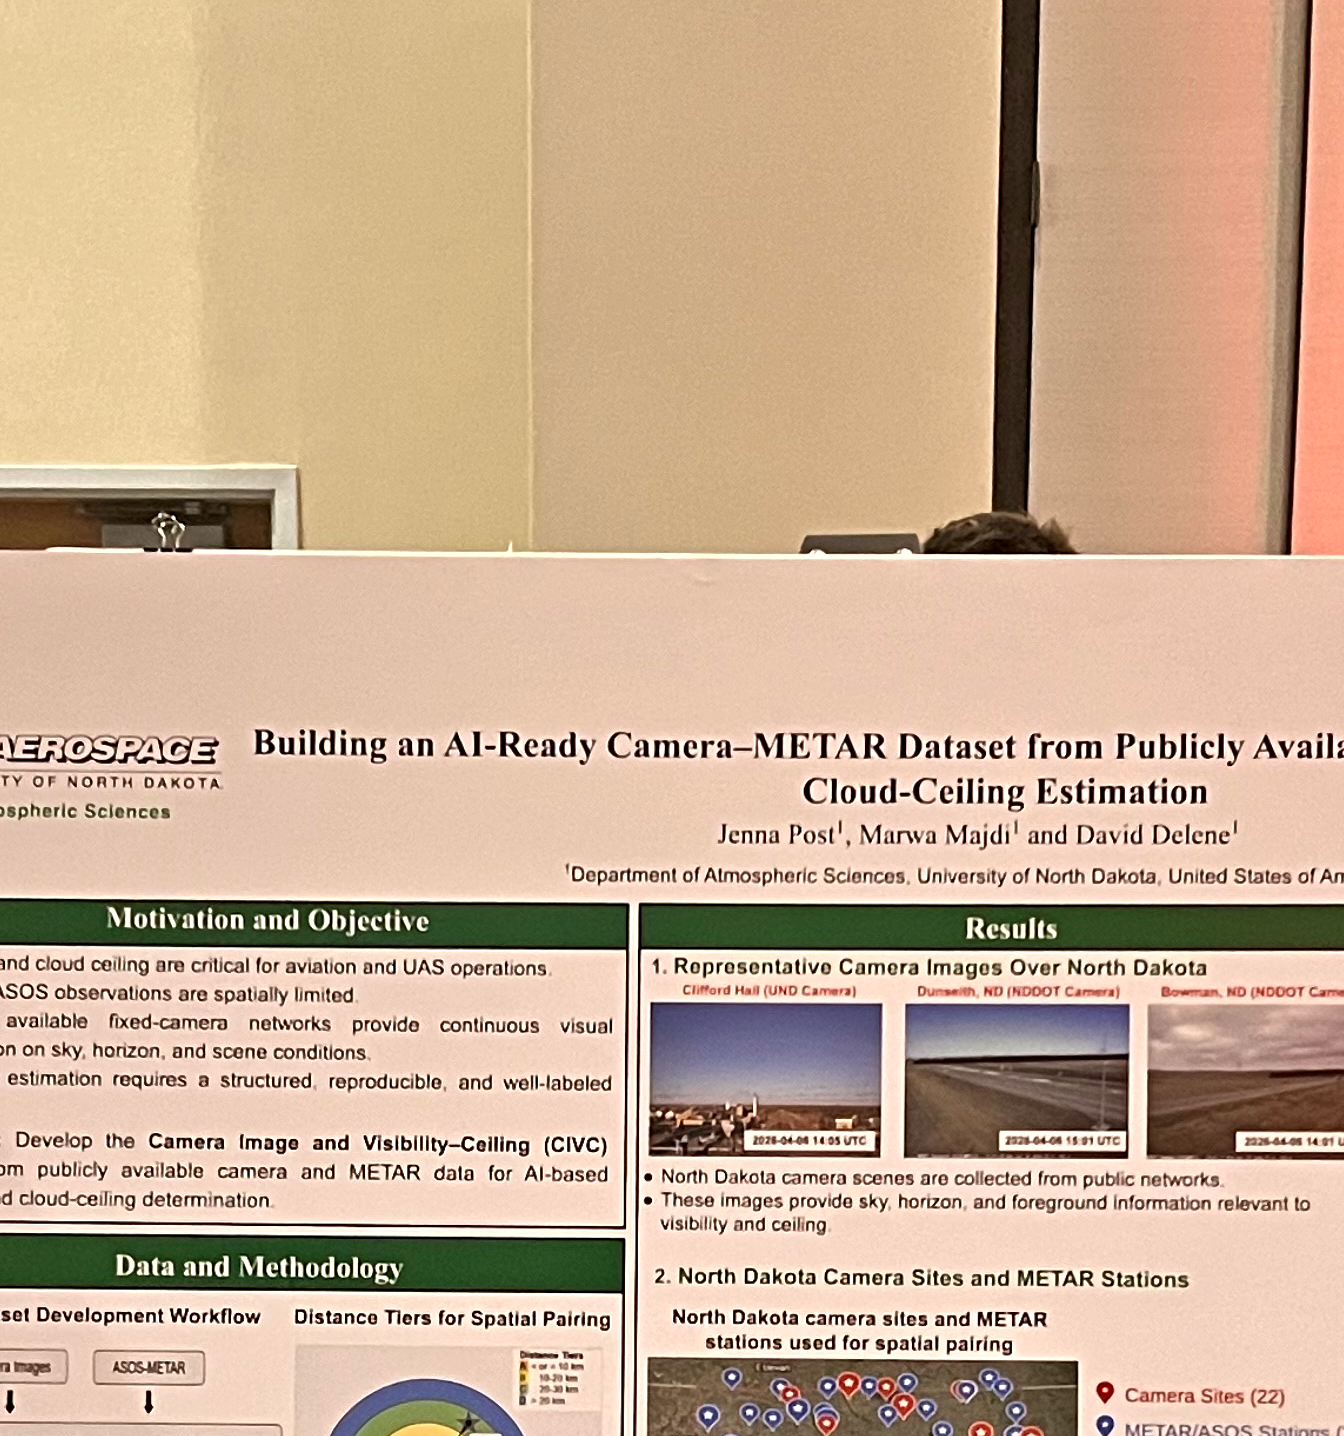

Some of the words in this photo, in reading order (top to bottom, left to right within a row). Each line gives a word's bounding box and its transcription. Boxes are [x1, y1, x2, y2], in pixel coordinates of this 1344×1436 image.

[255, 729, 386, 764] Building
[399, 738, 433, 756] an
[444, 731, 596, 765] AI-Ready
[899, 733, 1016, 759] Dataset
[1028, 733, 1102, 759] from
[1116, 733, 1244, 766] Publicly
[33, 776, 56, 787] OF
[68, 776, 132, 788] NORTH
[144, 777, 223, 789] DAKOTA
[804, 777, 1024, 812] Cloud-Ceiling
[1038, 778, 1207, 804] Estimation
[85, 803, 170, 819] Sciences
[718, 824, 779, 844] Jenna
[860, 824, 936, 844] Marwa
[1028, 824, 1067, 844] and
[1077, 824, 1143, 845] David
[683, 867, 700, 883] of
[704, 867, 817, 887] Atmospheric
[918, 868, 1007, 887] University
[1013, 868, 1030, 884] of
[1036, 868, 1085, 884] North
[1169, 868, 1227, 884] United
[1234, 868, 1291, 884] States
[1298, 868, 1316, 884] of
[108, 907, 244, 929] Motivation
[253, 909, 299, 930] and
[309, 909, 429, 936] Objective
[966, 917, 1057, 939] Results
[36, 956, 84, 971] cloud
[91, 956, 149, 976] ceiling
[156, 960, 184, 972] are
[191, 958, 249, 973] critical
[256, 957, 280, 973] for
[286, 959, 356, 974] aviation
[363, 959, 396, 975] and
[404, 959, 444, 975] UAS
[653, 958, 666, 974] 1.
[675, 957, 831, 978] Representative
[840, 958, 919, 975] Camera
[927, 959, 1002, 980] Images
[1011, 959, 1061, 976] Over
[1068, 959, 1125, 976] North
[1134, 959, 1206, 976] Dakota
[843, 1135, 867, 1146] UTC
[117, 1254, 174, 1276] Data
[184, 1256, 229, 1277] and
[240, 1256, 403, 1285] Methodology
[655, 1268, 671, 1283] 2.
[679, 1267, 735, 1284] North
[745, 1268, 816, 1285] Dakota
[824, 1268, 904, 1286] Camera
[912, 1269, 963, 1286] Sites
[971, 1270, 1009, 1286] and
[1018, 1270, 1094, 1287] METAR
[1102, 1271, 1189, 1288] Stations
[37, 1307, 164, 1326] Development
[170, 1308, 260, 1324] Workflow
[295, 1309, 377, 1325] Distance
[384, 1310, 431, 1325] Tiers
[439, 1310, 464, 1325] for
[472, 1311, 536, 1329] Spatial
[544, 1311, 610, 1331] Pairing
[673, 1309, 725, 1324] North
[733, 1309, 798, 1325] Dakota
[806, 1314, 875, 1326] camera
[883, 1311, 927, 1326] sites
[935, 1312, 970, 1326] and
[978, 1312, 1047, 1327] METAR
[706, 1334, 782, 1350] stations
[790, 1335, 836, 1350] used
[843, 1335, 869, 1350] for
[876, 1335, 939, 1354] spatial
[947, 1336, 1012, 1356] pairing
[14, 1361, 51, 1376] Images
[113, 1361, 185, 1374] ASOS-METAR
[1125, 1388, 1195, 1403] Camera
[1201, 1388, 1244, 1404] Sites
[1251, 1388, 1285, 1408] (22)
